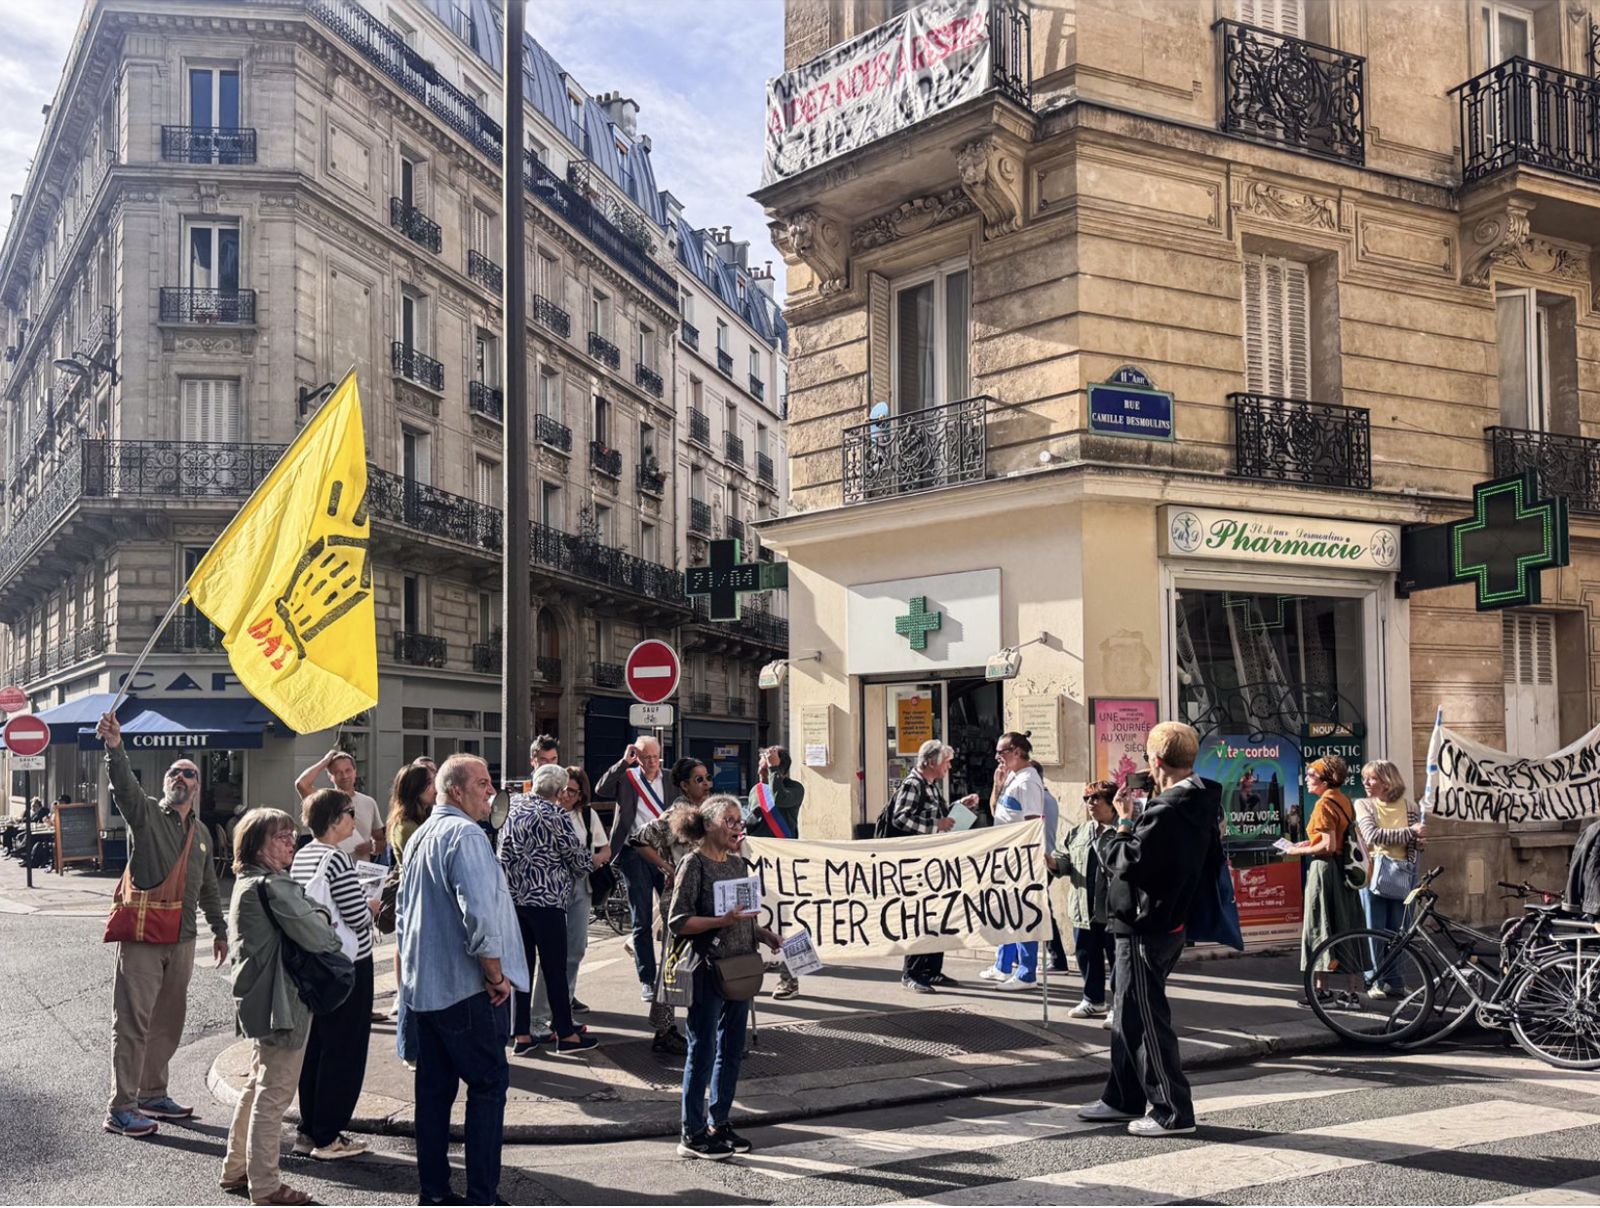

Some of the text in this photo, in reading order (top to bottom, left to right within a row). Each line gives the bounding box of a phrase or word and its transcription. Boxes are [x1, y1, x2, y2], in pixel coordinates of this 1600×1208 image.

[1124, 400, 1140, 410] RUE
[1092, 412, 1170, 430] CAMILLE DESMOULINS
[1205, 519, 1367, 560] Pharmacie
[118, 672, 242, 692] CAF
[1099, 712, 1119, 721] UNE
[1112, 721, 1151, 732] JOURNÉE
[133, 735, 209, 747] CONTENT
[1101, 733, 1113, 742] AU
[1125, 742, 1146, 752] SIÈCL
[1217, 741, 1279, 758] vtacorbol
[1545, 777, 1600, 820] LUTT
[776, 857, 812, 897] LE
[966, 843, 1041, 886] VEUT
